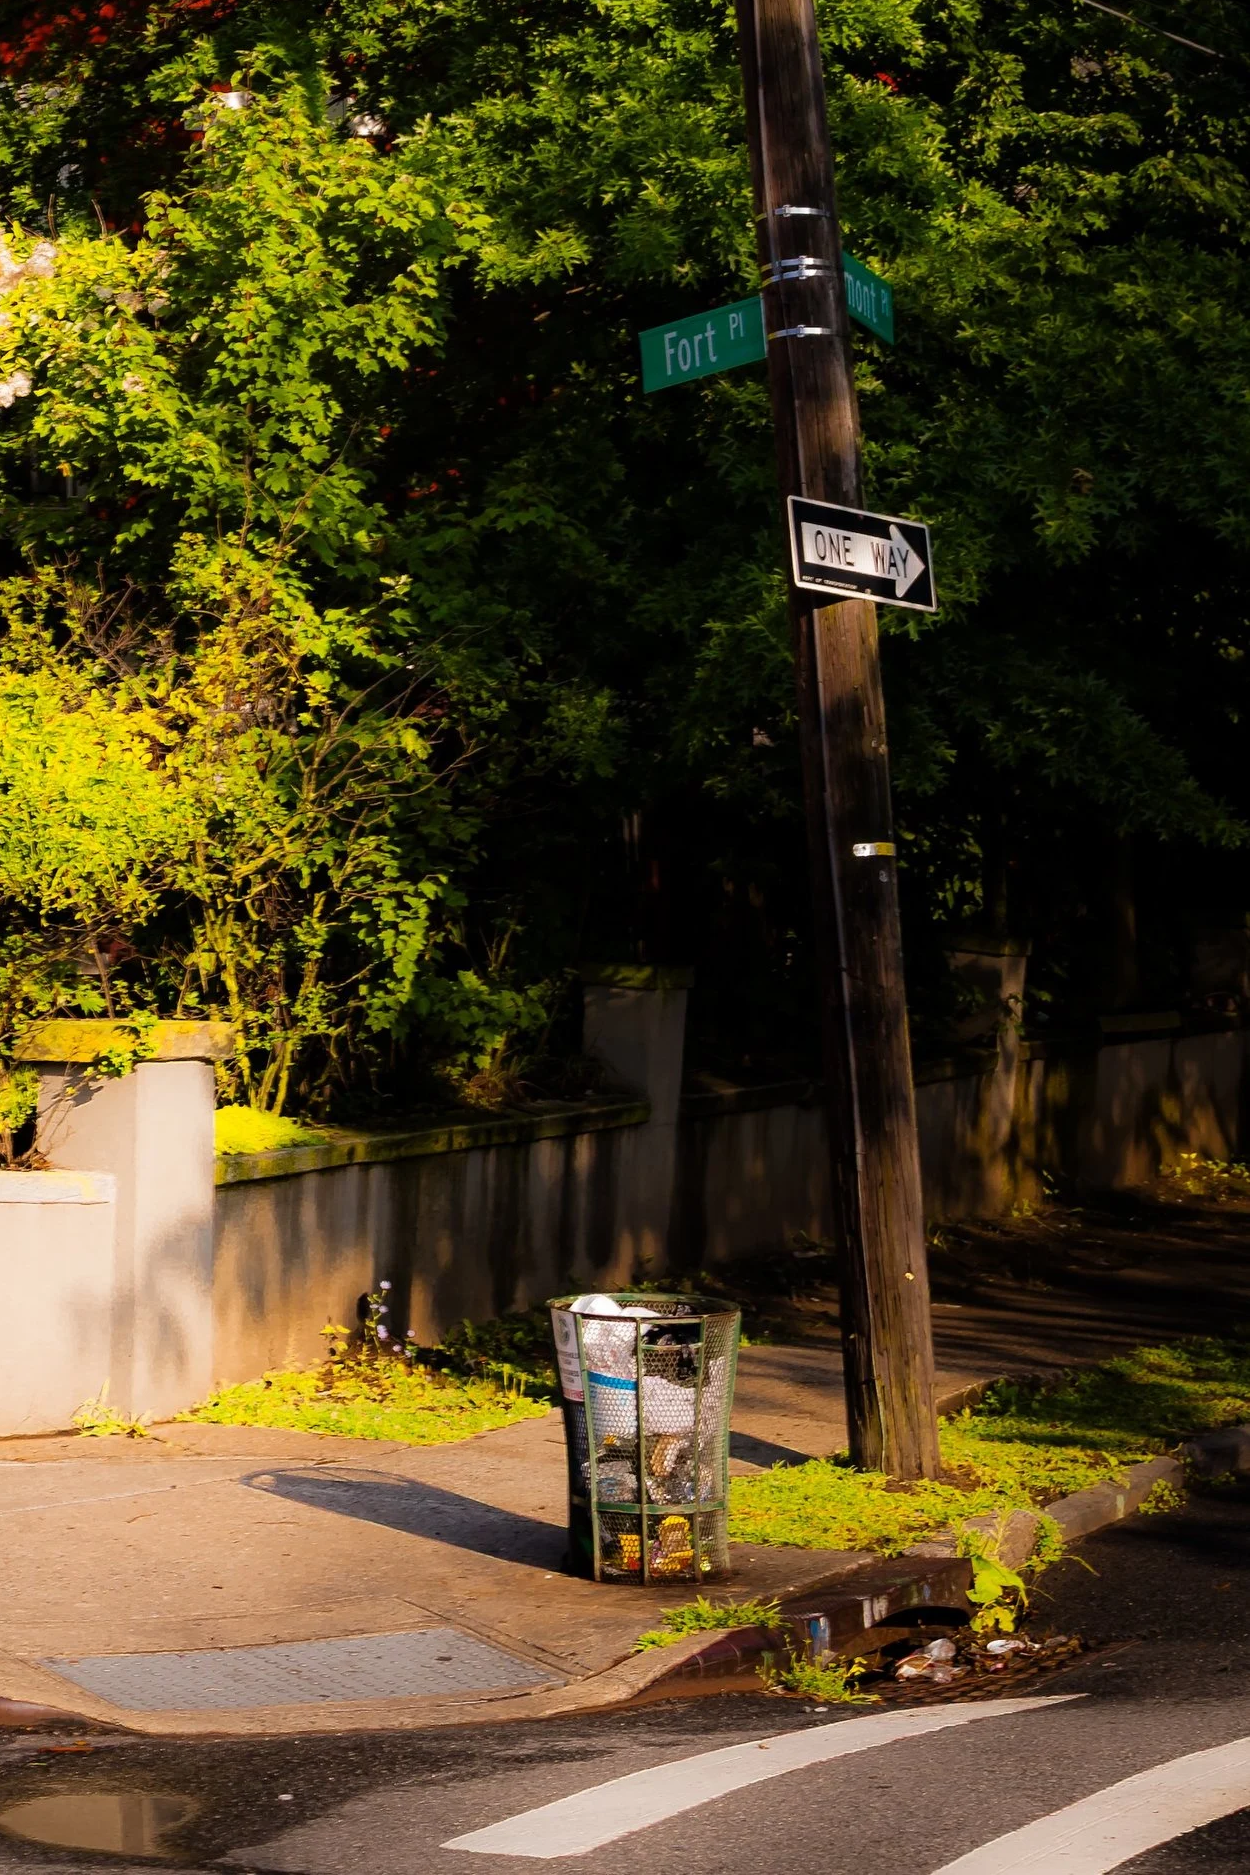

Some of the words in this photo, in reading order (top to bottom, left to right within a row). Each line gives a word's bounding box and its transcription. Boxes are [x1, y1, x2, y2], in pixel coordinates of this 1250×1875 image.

[664, 321, 718, 375] Fort
[729, 311, 744, 340] Pl
[814, 530, 855, 567] ONE
[871, 541, 909, 579] WAY
